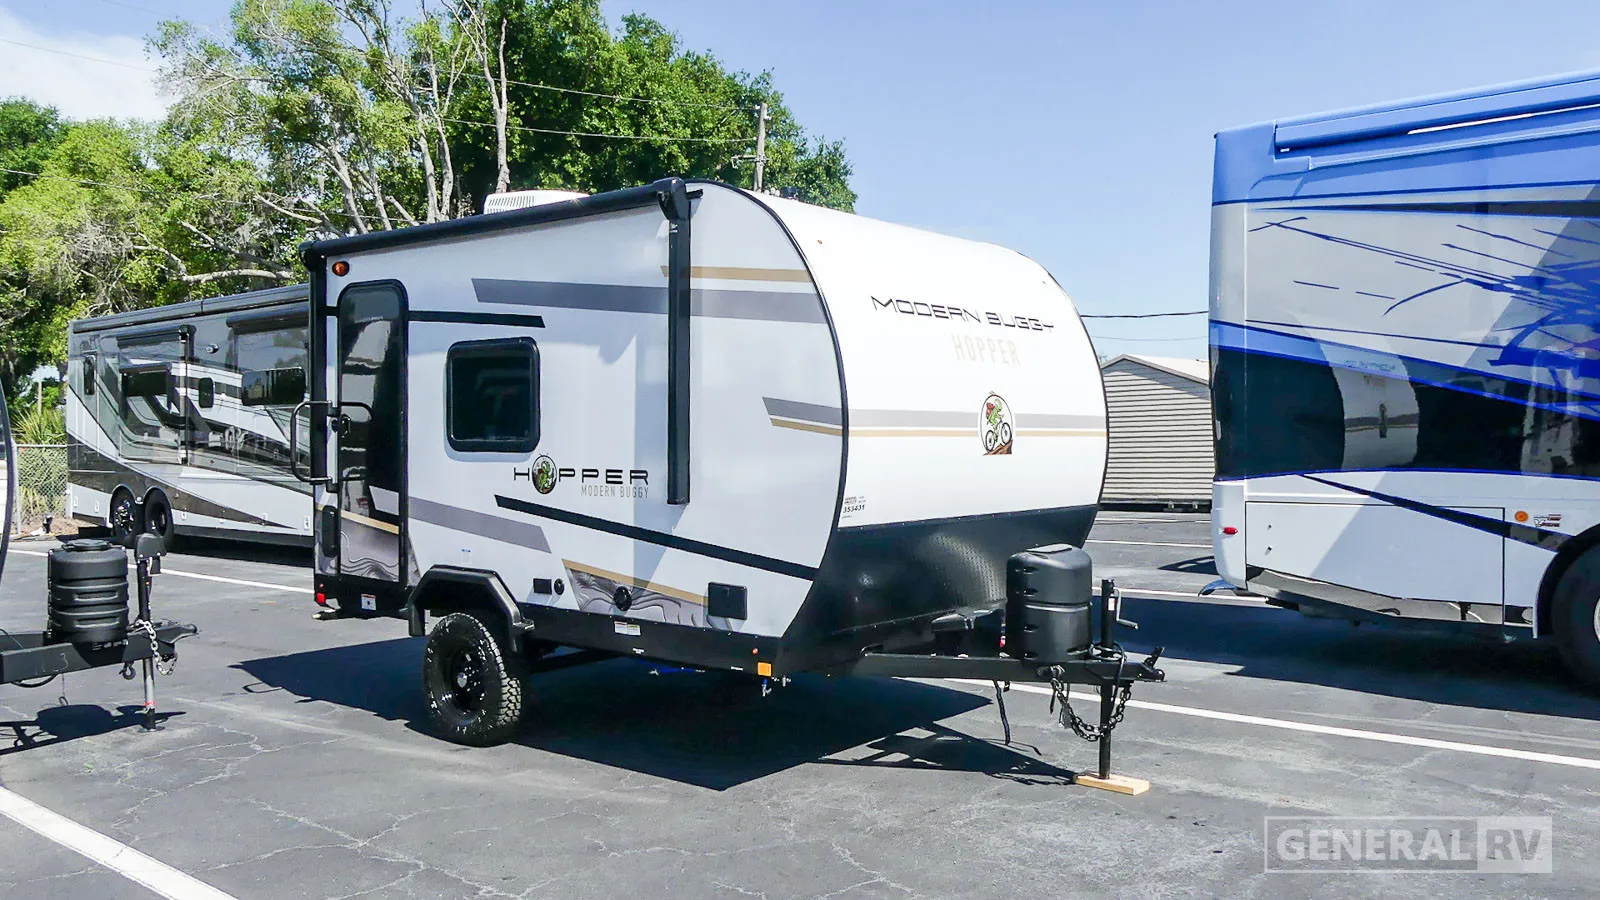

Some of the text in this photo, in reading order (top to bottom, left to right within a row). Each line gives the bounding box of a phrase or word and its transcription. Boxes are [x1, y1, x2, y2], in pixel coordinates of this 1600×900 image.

[871, 296, 1055, 332] MODERN BUGGY
[951, 333, 1021, 366] HOPPER
[581, 484, 649, 499] MODERN BUGGY
